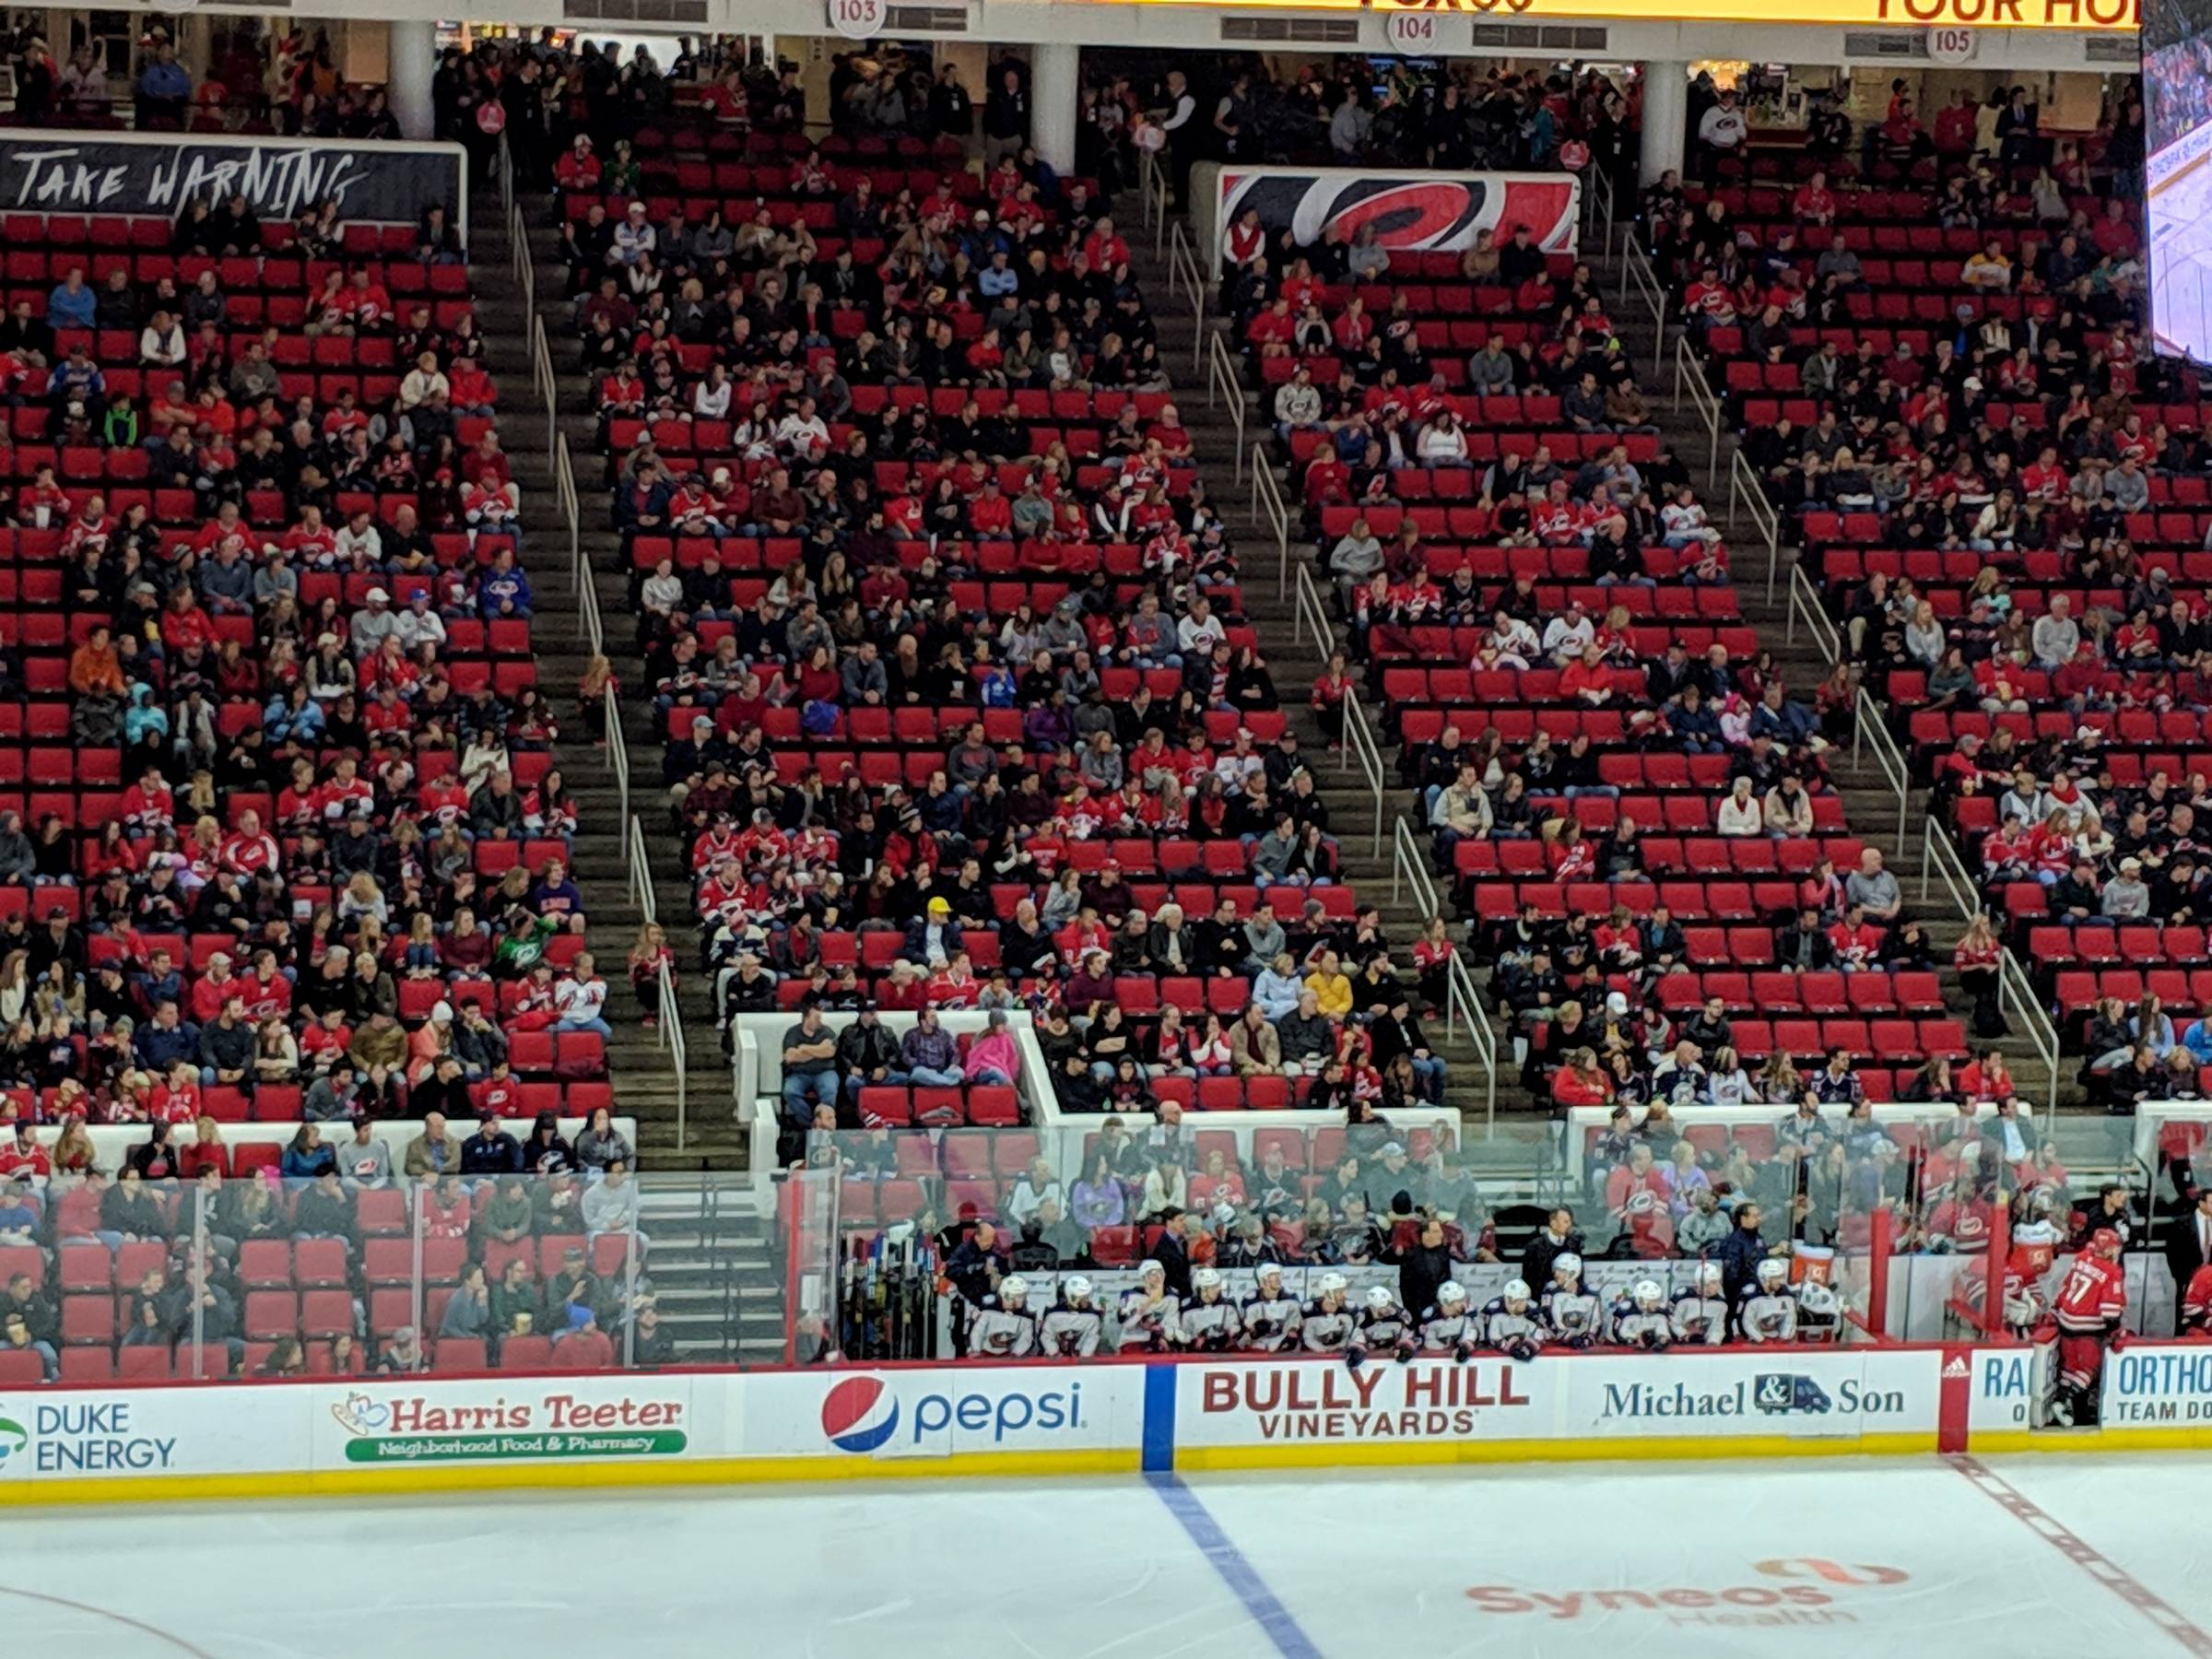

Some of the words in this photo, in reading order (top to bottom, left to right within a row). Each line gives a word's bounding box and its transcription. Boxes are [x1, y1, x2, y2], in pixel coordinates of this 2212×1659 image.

[840, 0, 876, 22] 103
[2043, 0, 2140, 24] HO
[1397, 18, 1432, 39] 104
[1936, 30, 1971, 52] 105
[11, 147, 129, 206] TAKE
[146, 144, 371, 219] WARNING
[1203, 1368, 1386, 1413] BULLY
[1405, 1365, 1530, 1407] HILL
[2119, 1354, 2212, 1395] ORTHO
[913, 1382, 1081, 1443] pepsi
[1601, 1381, 1745, 1418] Michael
[1760, 1375, 1787, 1403] &
[1839, 1379, 1904, 1413] Son
[2117, 1401, 2177, 1421] TEAM
[38, 1403, 130, 1435] DUKE
[389, 1397, 531, 1432] Harris
[544, 1394, 682, 1430] Teeter
[1259, 1410, 1475, 1439] VINEYARDS
[38, 1438, 176, 1471] ENERGY
[378, 1439, 497, 1457] Neighborhood
[501, 1436, 542, 1453] Food
[546, 1436, 564, 1452] &
[568, 1435, 655, 1454] Pharmacy
[1465, 1585, 1833, 1619] Syneos
[1666, 1608, 1859, 1628] Health
